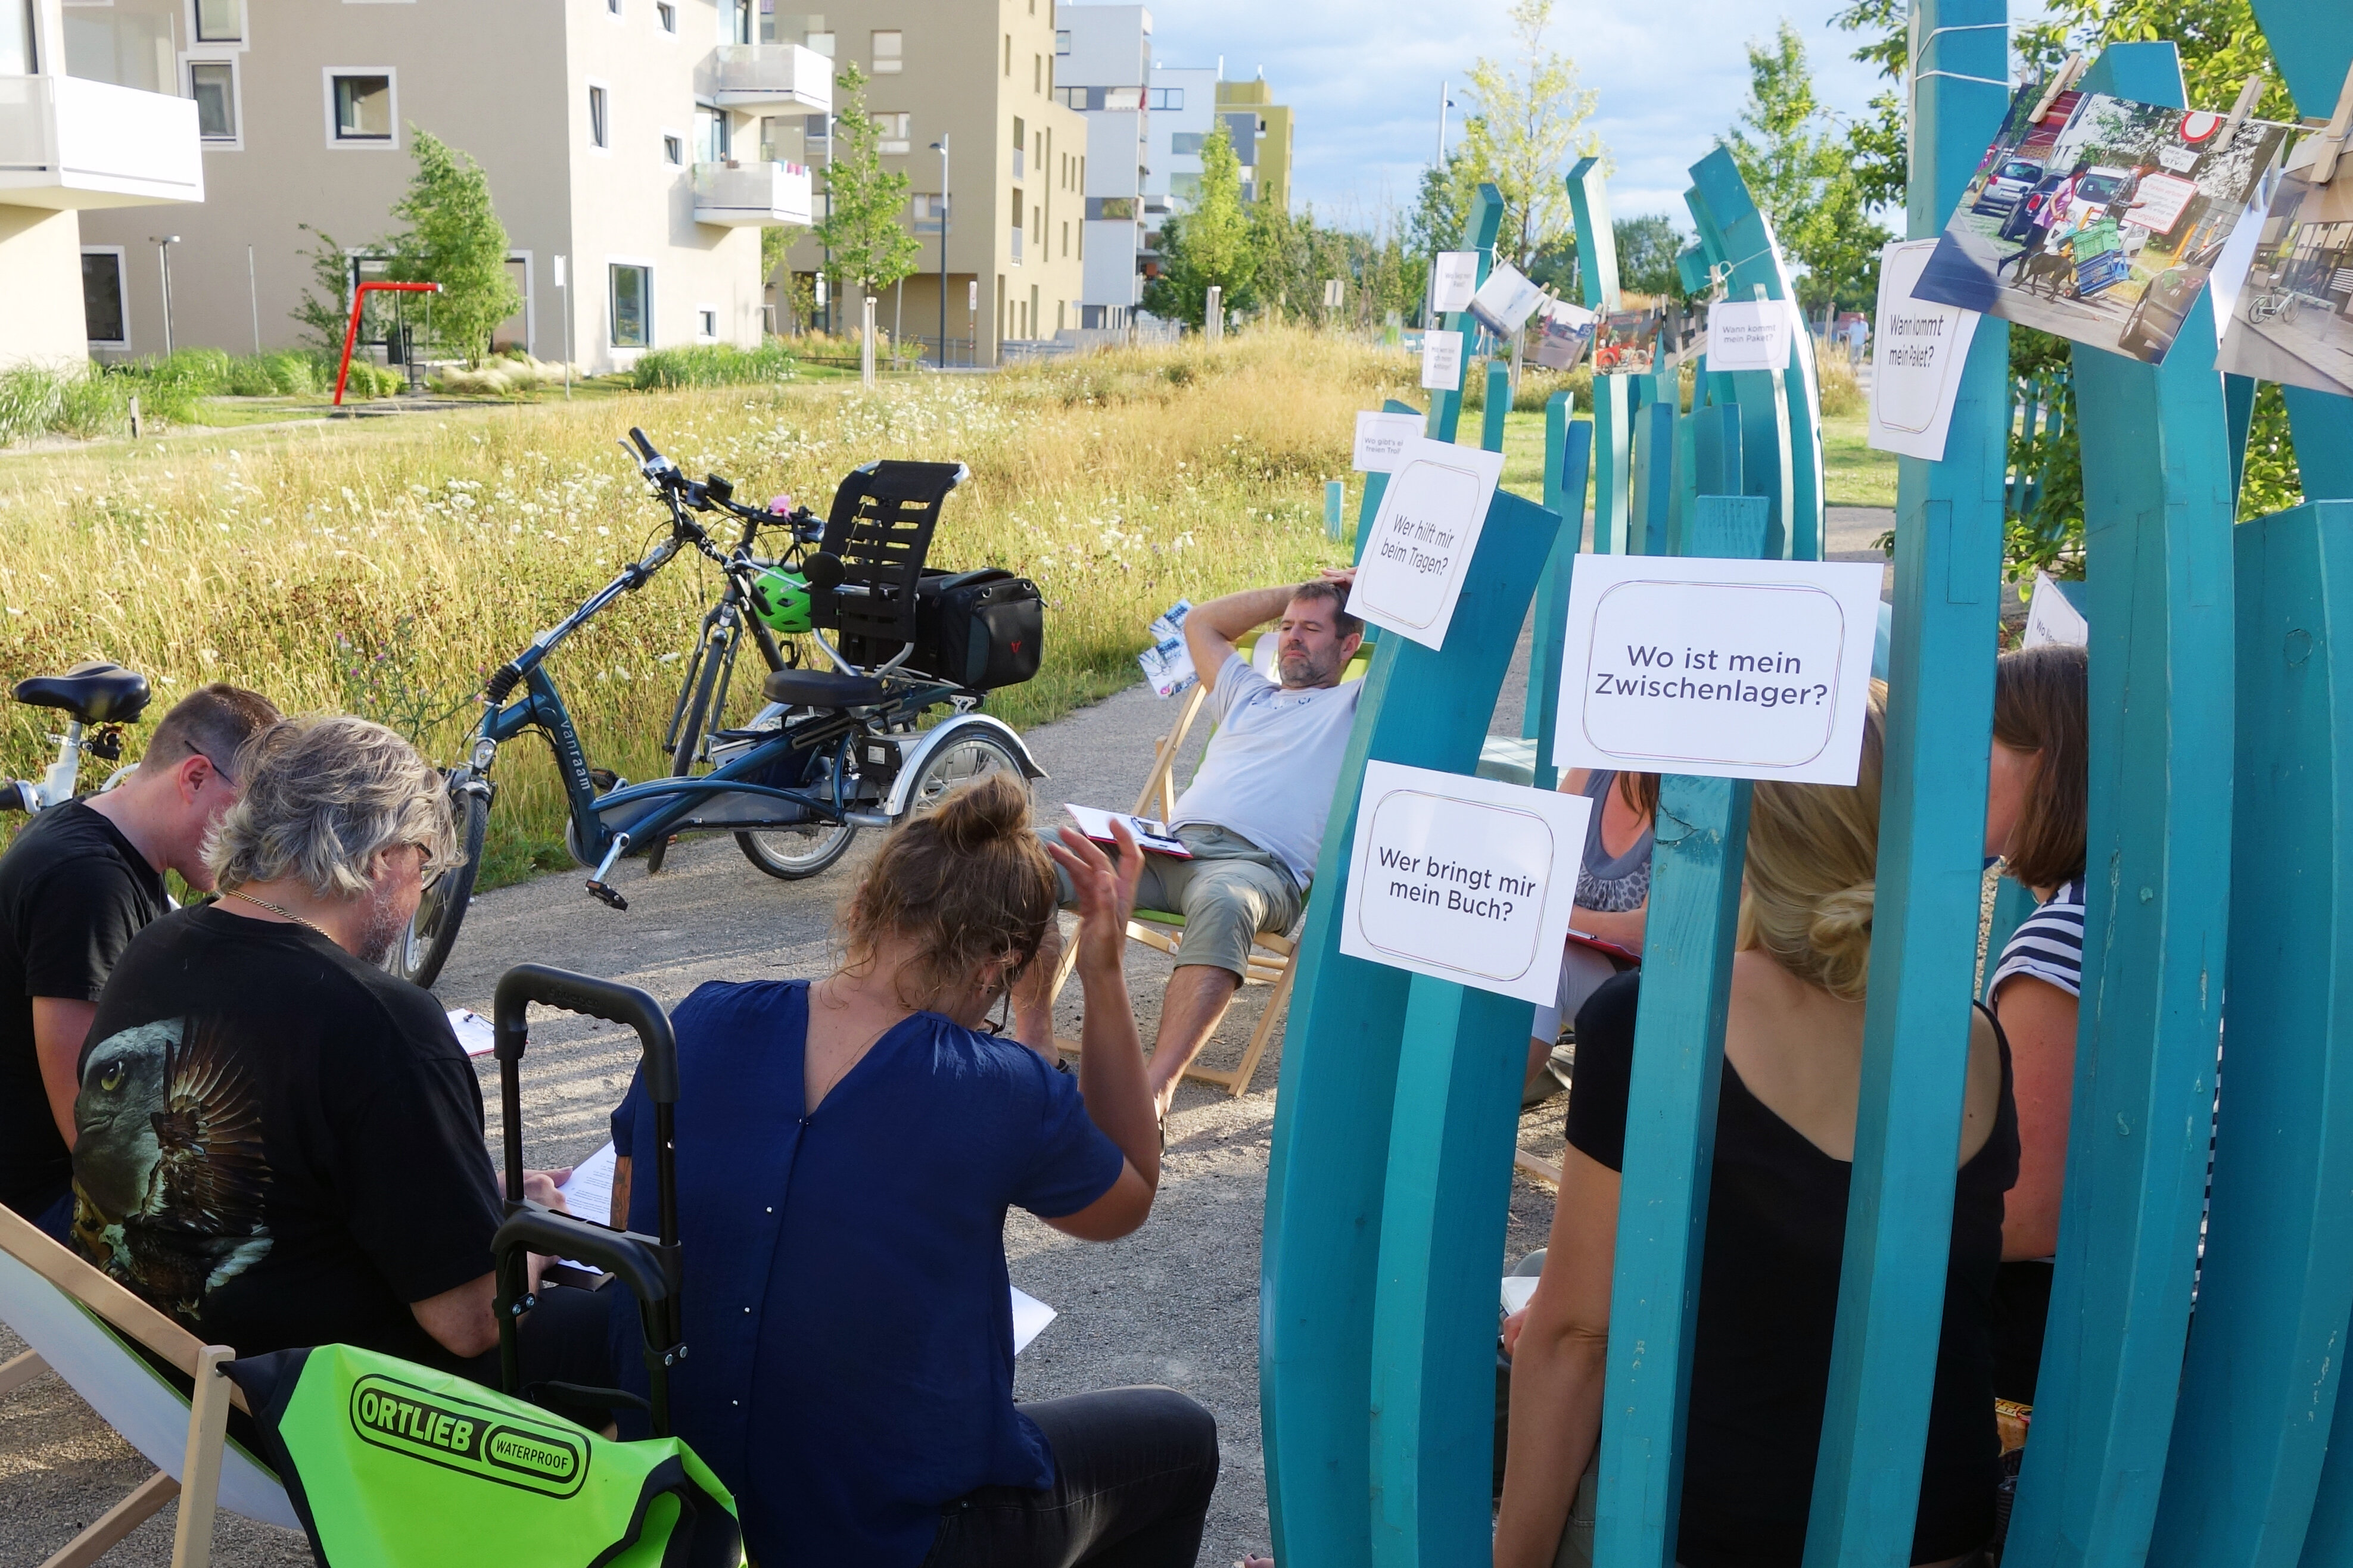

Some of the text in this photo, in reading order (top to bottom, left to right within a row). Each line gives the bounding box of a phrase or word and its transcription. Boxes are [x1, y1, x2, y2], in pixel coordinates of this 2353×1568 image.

[1580, 325, 1593, 335] 35
[1890, 313, 1944, 336] Wann kommt
[1889, 344, 1934, 367] mein Paket?
[1378, 438, 1395, 447] gibt's
[1393, 513, 1455, 549] Wer hilft mir
[1381, 537, 1448, 576] beim Tragen?
[2037, 618, 2045, 636] Wo
[1627, 645, 1801, 674] Wo ist mein
[1595, 673, 1828, 707] Zwischenlager?
[561, 720, 590, 790] vanraam
[1380, 846, 1536, 897] Wer bringt mir
[1390, 881, 1513, 921] mein Buch?
[362, 1392, 569, 1470] ORTLIEB WATERPROOF
